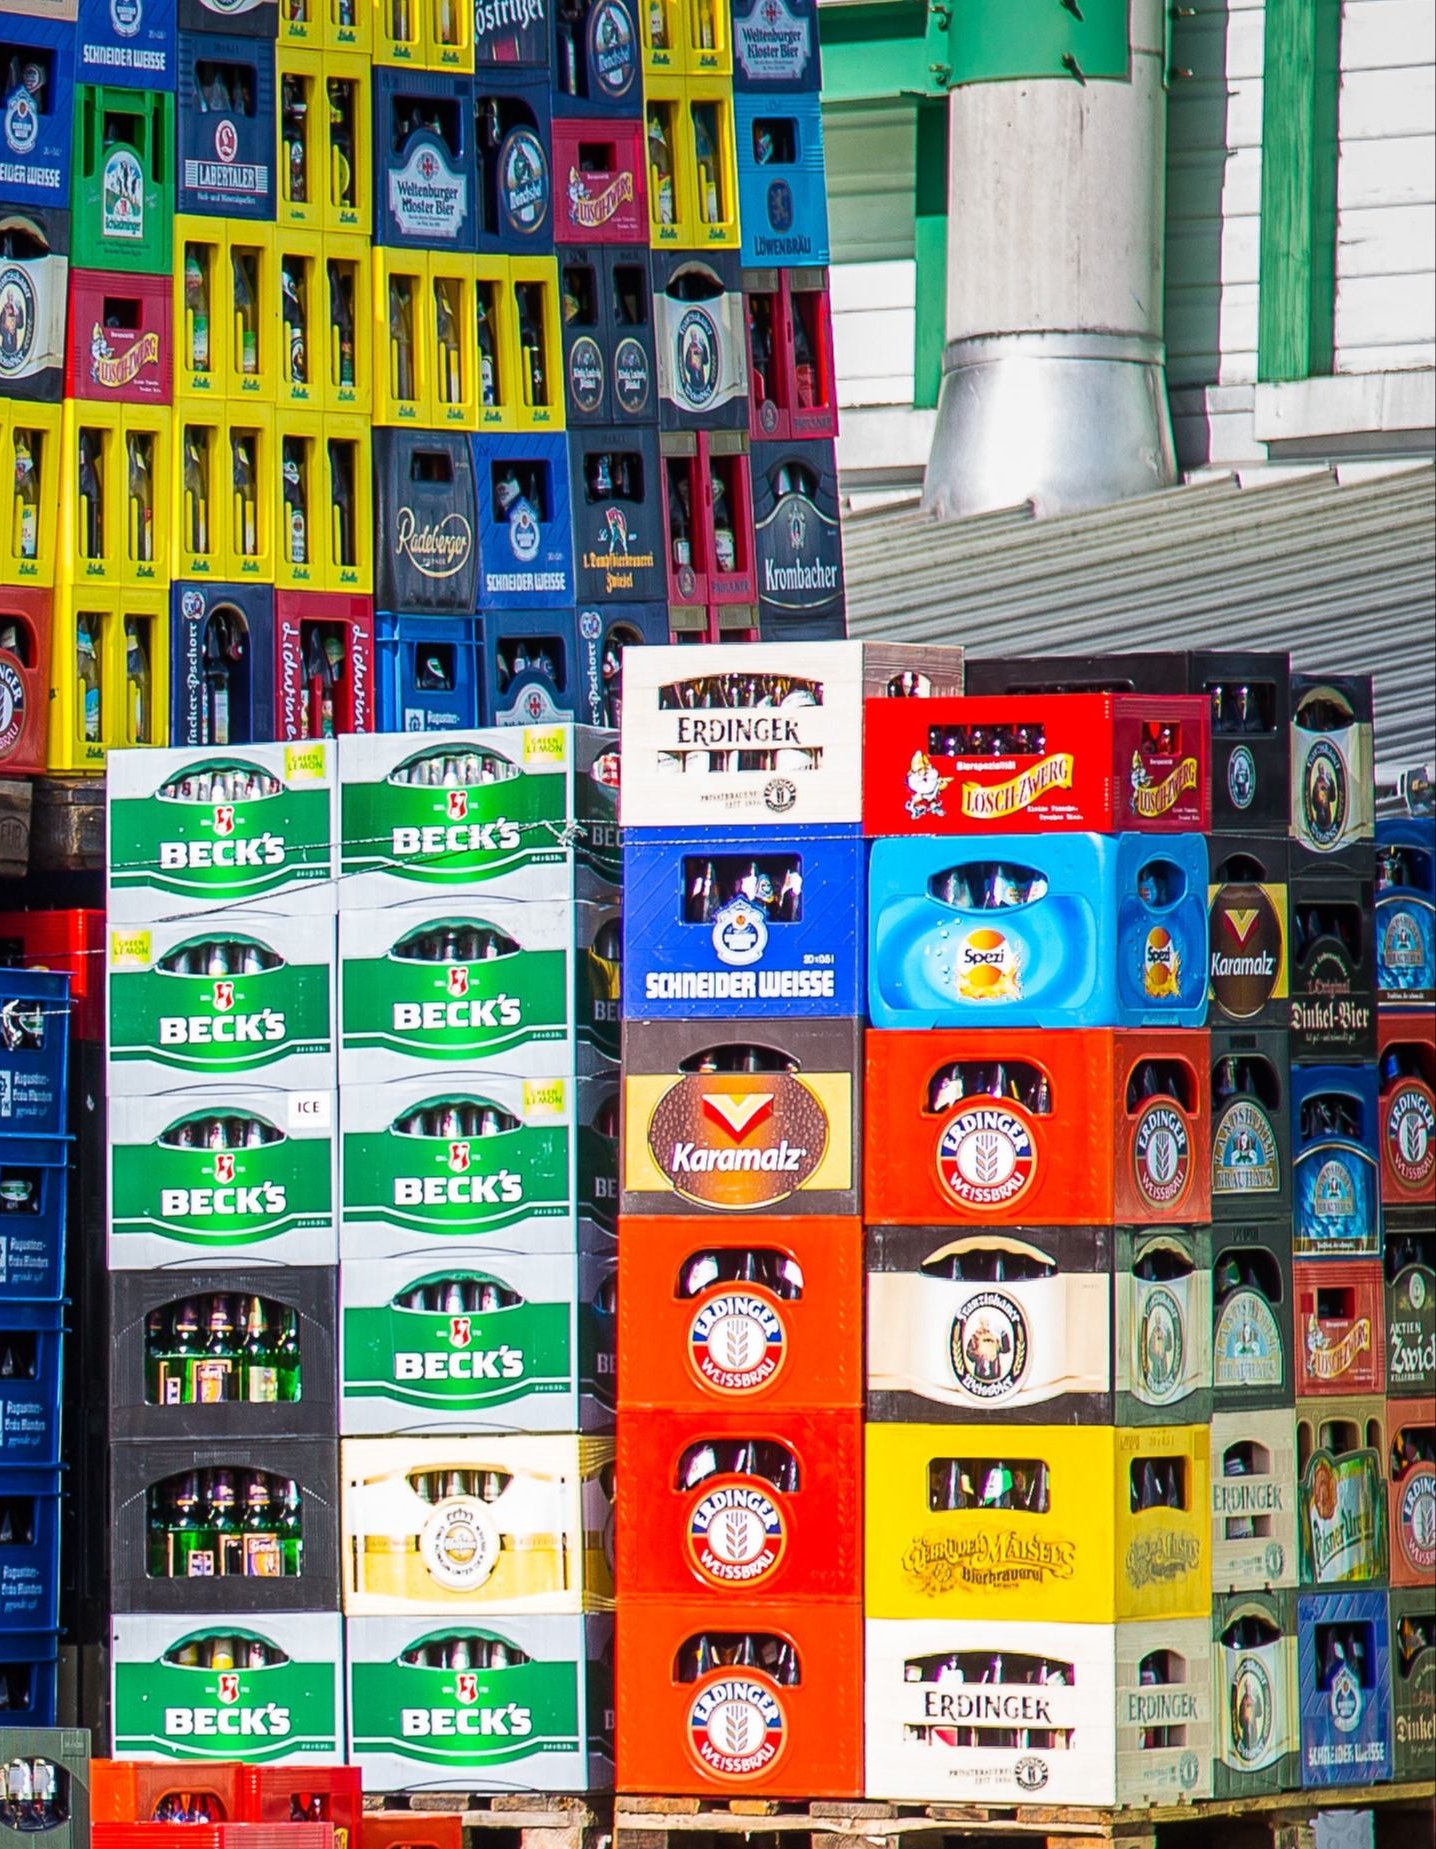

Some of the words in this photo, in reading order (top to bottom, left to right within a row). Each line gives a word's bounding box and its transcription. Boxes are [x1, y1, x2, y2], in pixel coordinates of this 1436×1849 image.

[25, 166, 61, 189] WEISSE
[199, 165, 256, 189] LABERTALER
[579, 178, 632, 221] LÖSCH-ZWERG
[754, 235, 812, 256] LÖWENBRÄU
[396, 506, 468, 558] Radeberger
[764, 559, 837, 591] Krombacher
[677, 716, 802, 747] ERDINGER
[287, 760, 323, 771] LEMON
[966, 760, 1069, 813] LÖSCH-ZWERG
[160, 832, 285, 869] BECK'S
[392, 821, 521, 855] BECK'S
[963, 947, 1005, 967] Spezi
[1210, 950, 1274, 977] Karamalz
[645, 972, 757, 999] SCHNEIDER
[759, 970, 835, 998] WEISSE
[1291, 1002, 1370, 1031] Dinkel-Bier
[298, 1101, 320, 1114] ICE
[943, 1109, 1029, 1157] ERDINGER
[672, 1141, 802, 1175] Karamalz
[949, 1172, 1026, 1204] WEISSBRÄU
[1212, 1481, 1282, 1511] ERDINGER
[961, 1567, 1044, 1586] Bierbrauerei
[692, 1682, 779, 1726] ERDINGER
[924, 1690, 1052, 1724] ERDINGER
[165, 1704, 291, 1737] BECK'S
[701, 1744, 776, 1775] WEISSBRÄU
